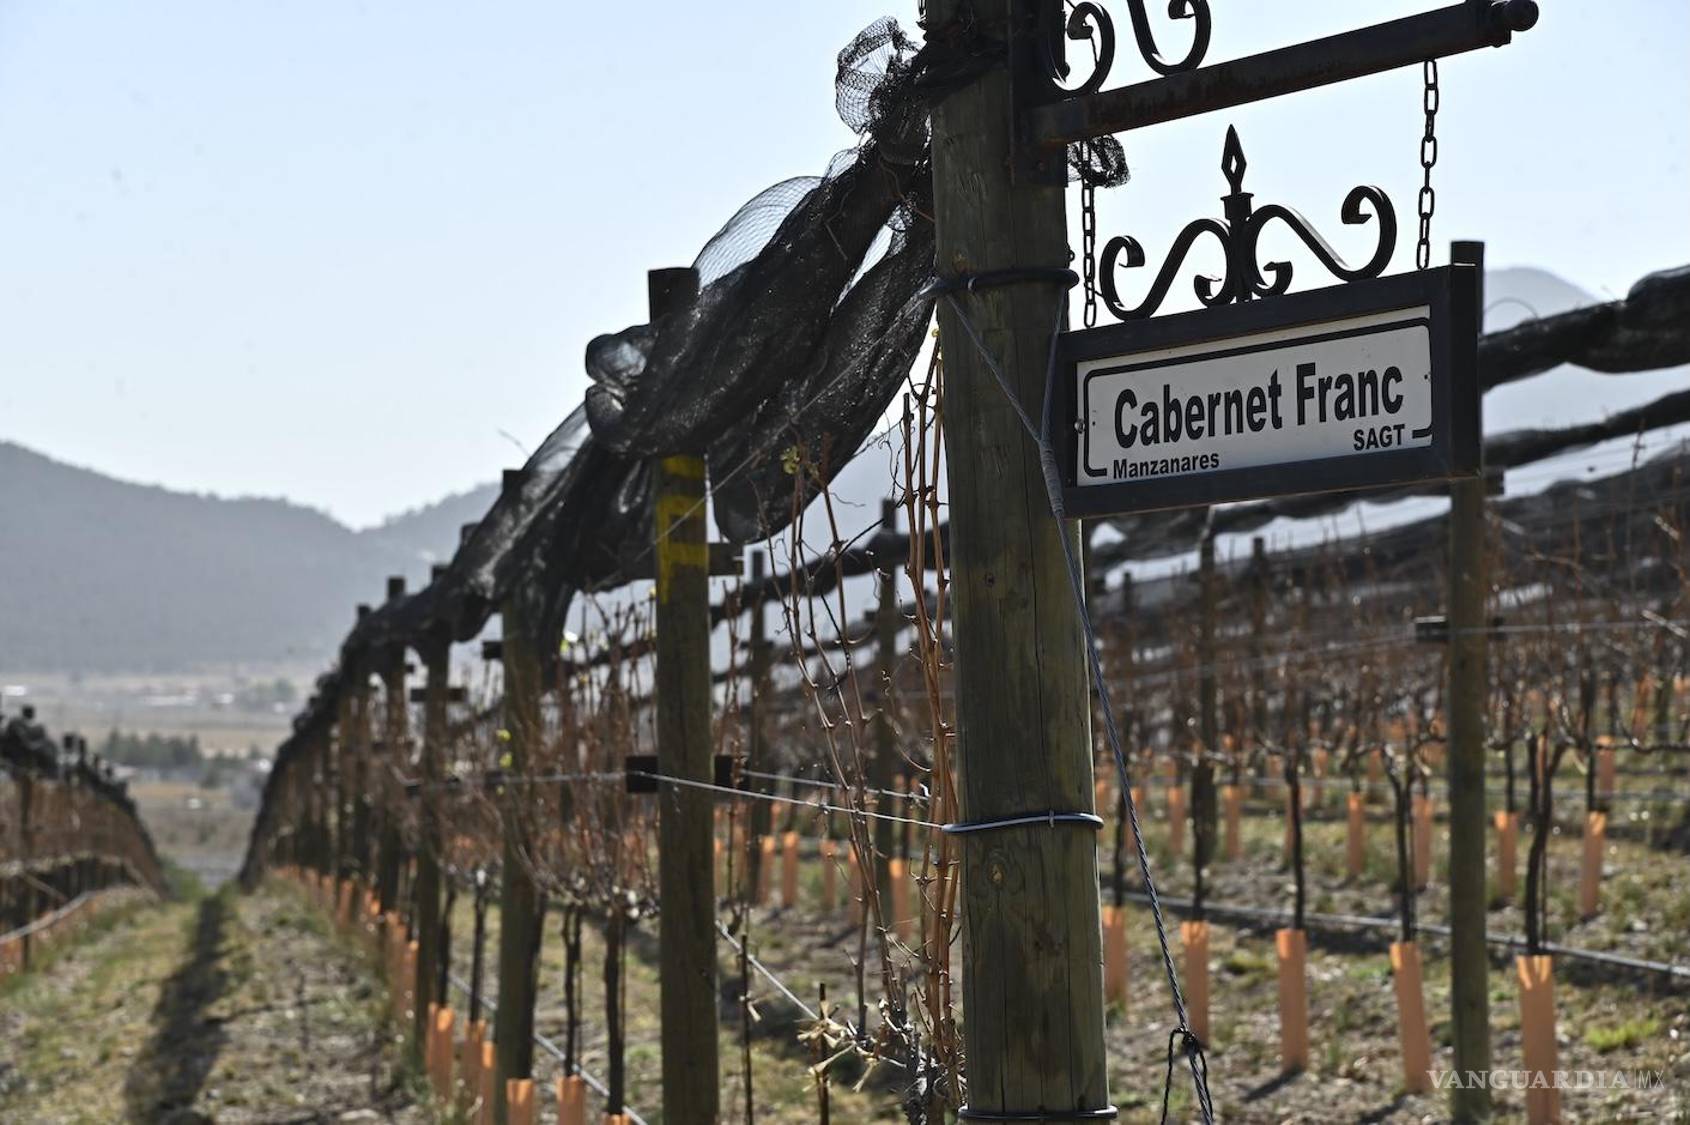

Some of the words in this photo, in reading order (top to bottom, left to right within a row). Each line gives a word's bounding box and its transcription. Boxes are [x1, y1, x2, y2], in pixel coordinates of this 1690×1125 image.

[1114, 368, 1283, 449] Cabernet
[1296, 362, 1404, 426] Franc
[1353, 424, 1405, 451] SAGT
[1113, 452, 1220, 480] Manzanares
